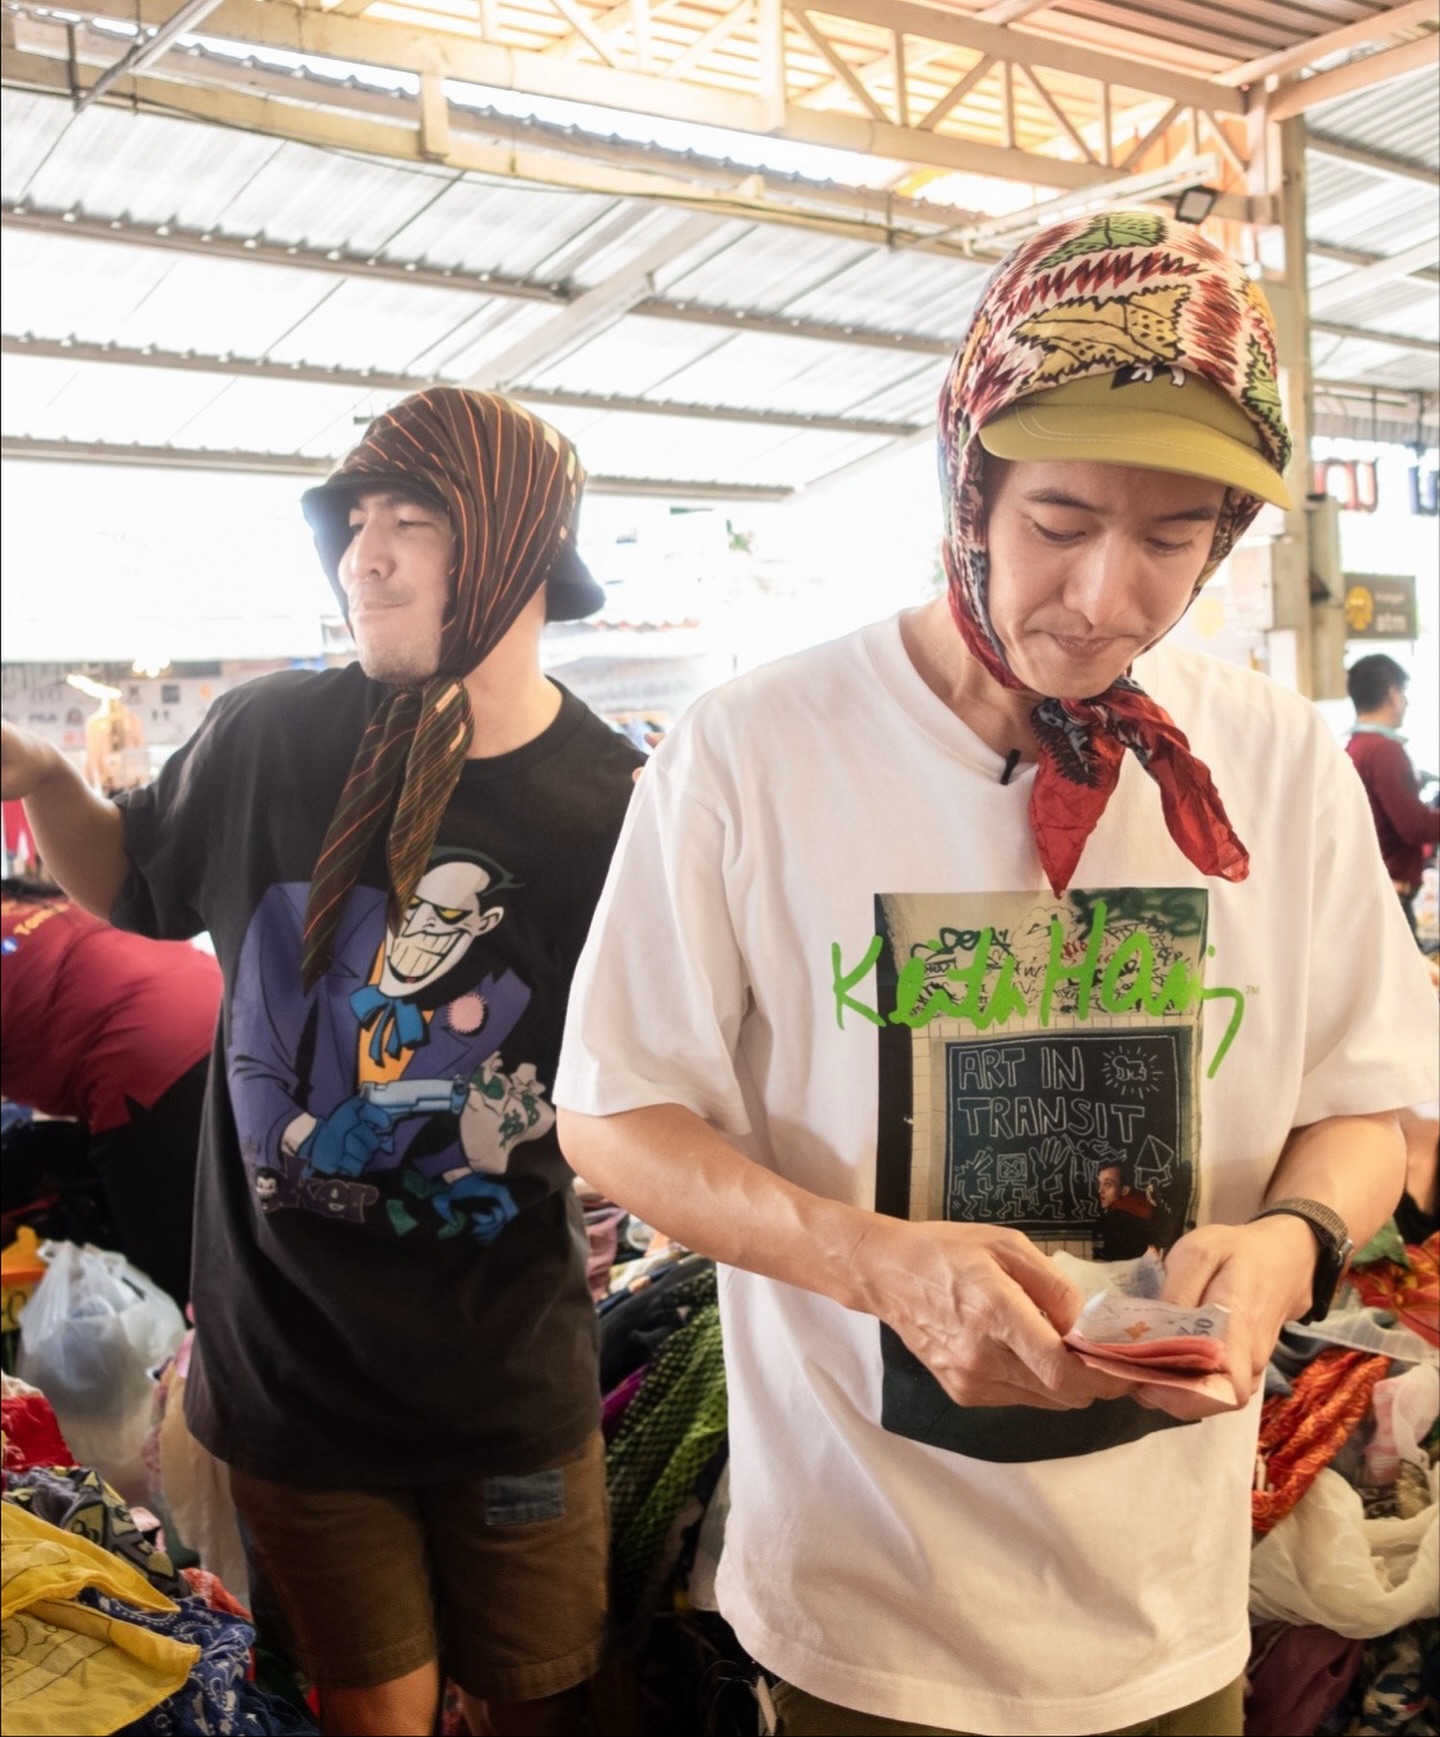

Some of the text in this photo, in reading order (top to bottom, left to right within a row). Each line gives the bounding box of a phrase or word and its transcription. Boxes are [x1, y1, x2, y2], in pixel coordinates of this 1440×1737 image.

[831, 927, 1028, 1030] Keith
[958, 1046, 1084, 1091] ART IN
[957, 1097, 1146, 1142] TRANSIT
